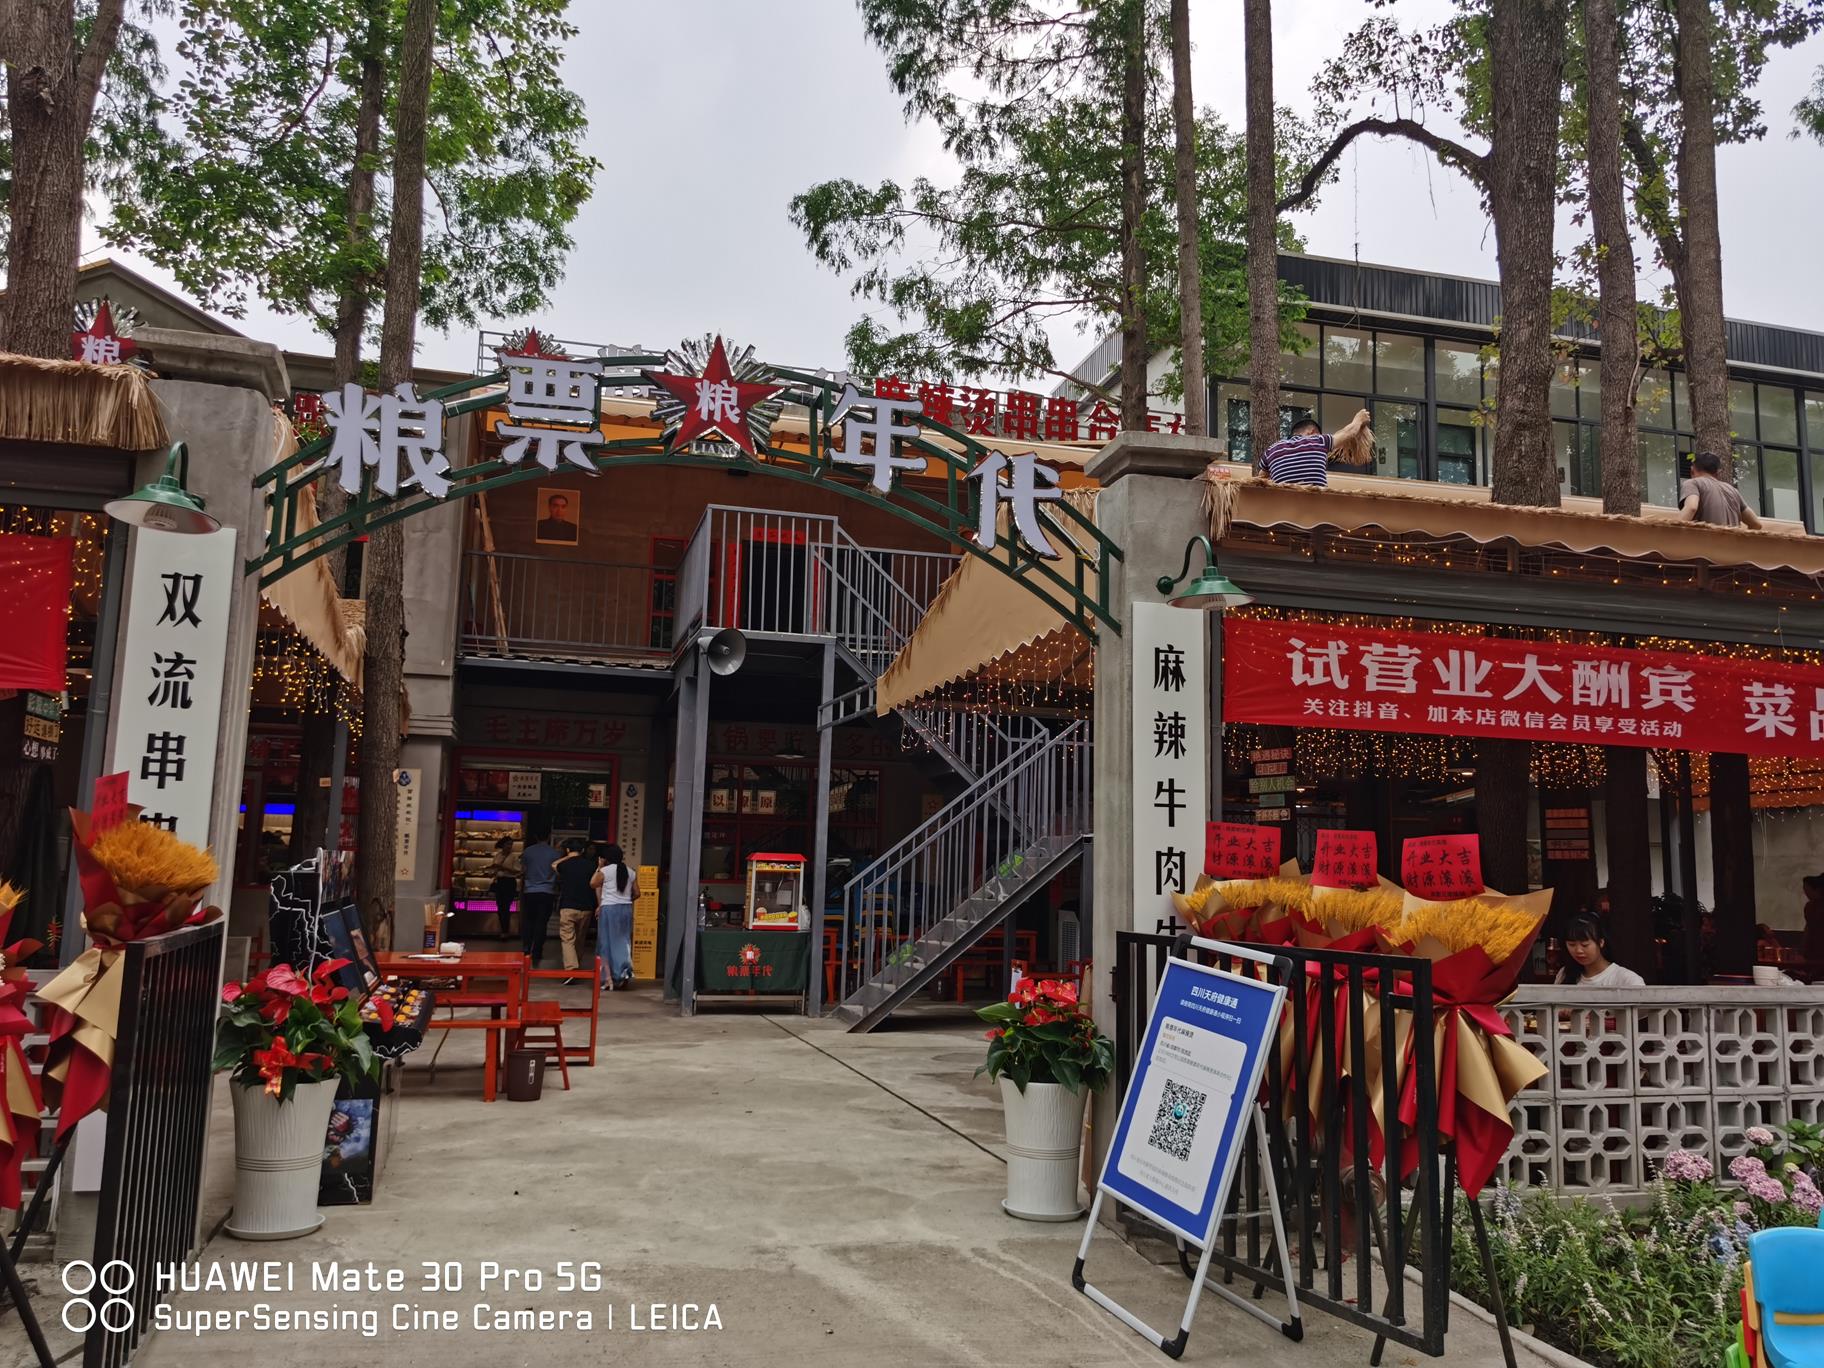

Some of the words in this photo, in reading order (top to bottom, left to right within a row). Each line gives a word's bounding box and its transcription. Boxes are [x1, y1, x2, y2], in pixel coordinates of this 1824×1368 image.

[80, 335, 122, 366] 粮
[694, 379, 741, 424] 粮
[691, 441, 739, 458] LIANG
[1285, 637, 1698, 713] 试营业大酬宾
[485, 714, 627, 746] 毛主席万岁
[1319, 842, 1373, 860] 开业大吉
[1406, 846, 1473, 867] 开业大吉
[1190, 985, 1239, 1009] 四川天府健康通
